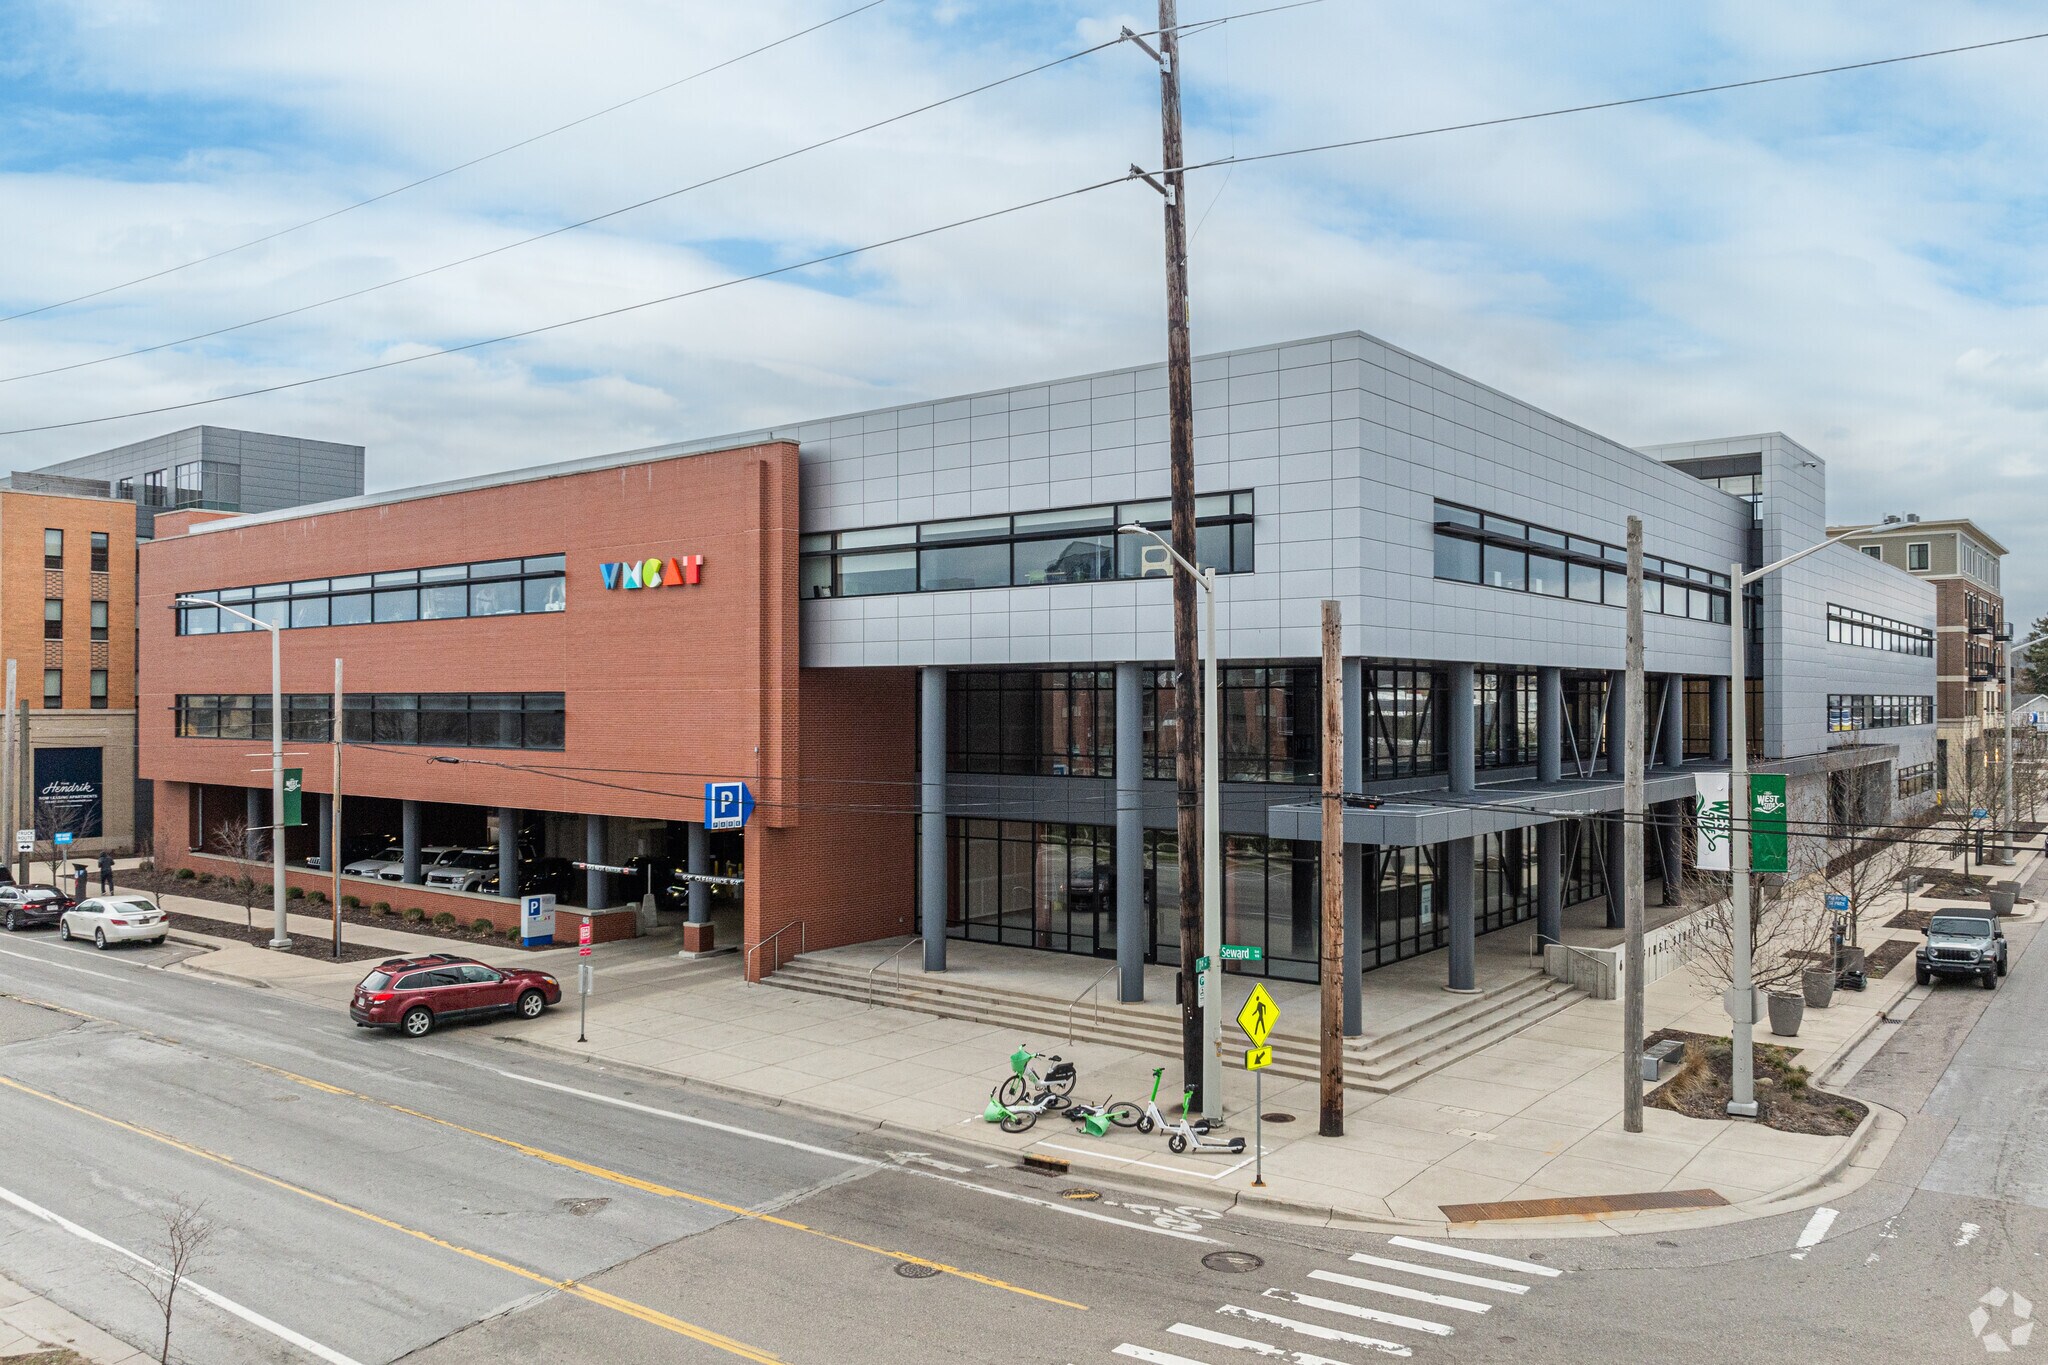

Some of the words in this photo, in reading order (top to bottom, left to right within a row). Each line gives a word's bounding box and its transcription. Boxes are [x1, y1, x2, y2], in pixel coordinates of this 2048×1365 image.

[599, 554, 704, 590] WMCAT
[42, 781, 94, 794] Hendrik
[721, 791, 733, 813] P
[1757, 795, 1780, 805] WEST
[694, 875, 728, 884] CLEARANCE
[530, 901, 539, 914] P
[1221, 946, 1249, 959] Seward
